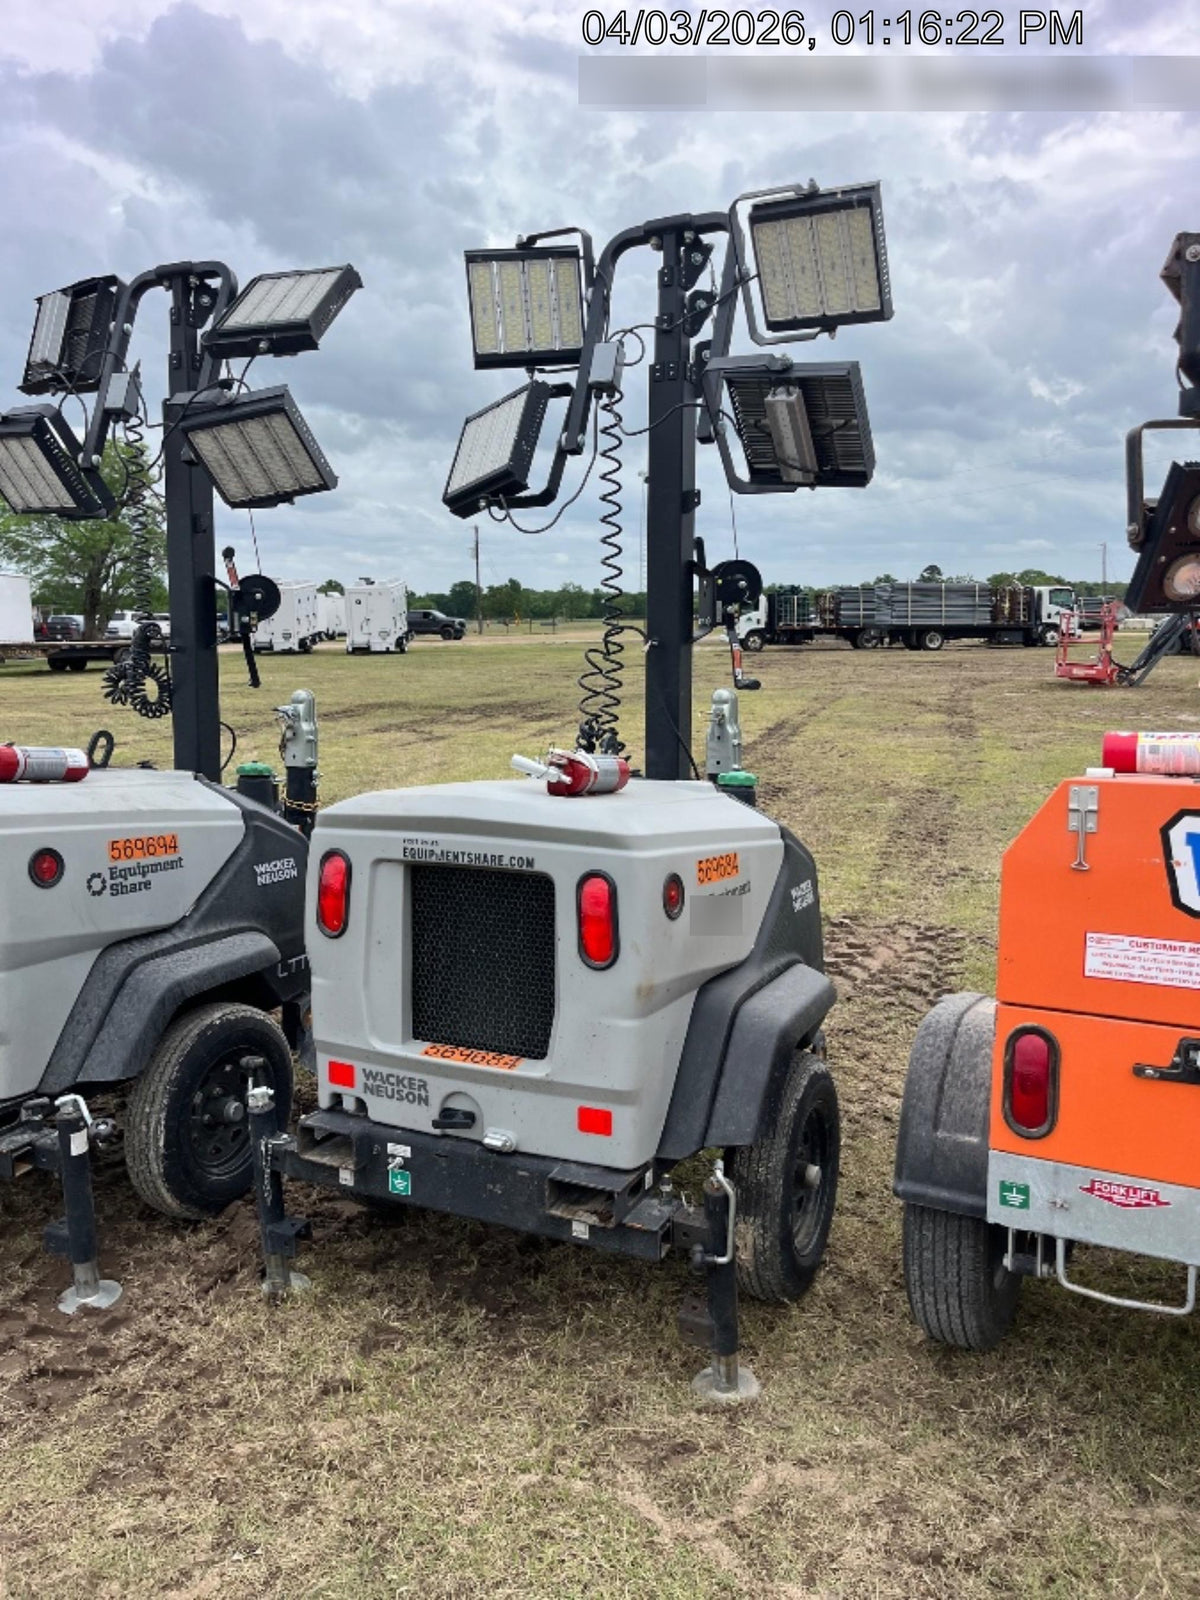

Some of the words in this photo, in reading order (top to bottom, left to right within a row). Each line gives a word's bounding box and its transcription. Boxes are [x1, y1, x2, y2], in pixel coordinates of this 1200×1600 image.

[110, 835, 178, 861] 569694
[402, 847, 535, 869] EQUIPMENTSHARE.COM
[107, 856, 184, 882] Equipment
[253, 857, 296, 875] WACKER
[256, 867, 298, 886] NEUSON
[109, 879, 152, 897] Share
[361, 1067, 429, 1093] WACKER
[362, 1081, 430, 1107] NEUSON
[1093, 1181, 1127, 1196] FORK
[1128, 1187, 1157, 1201] LIFT
